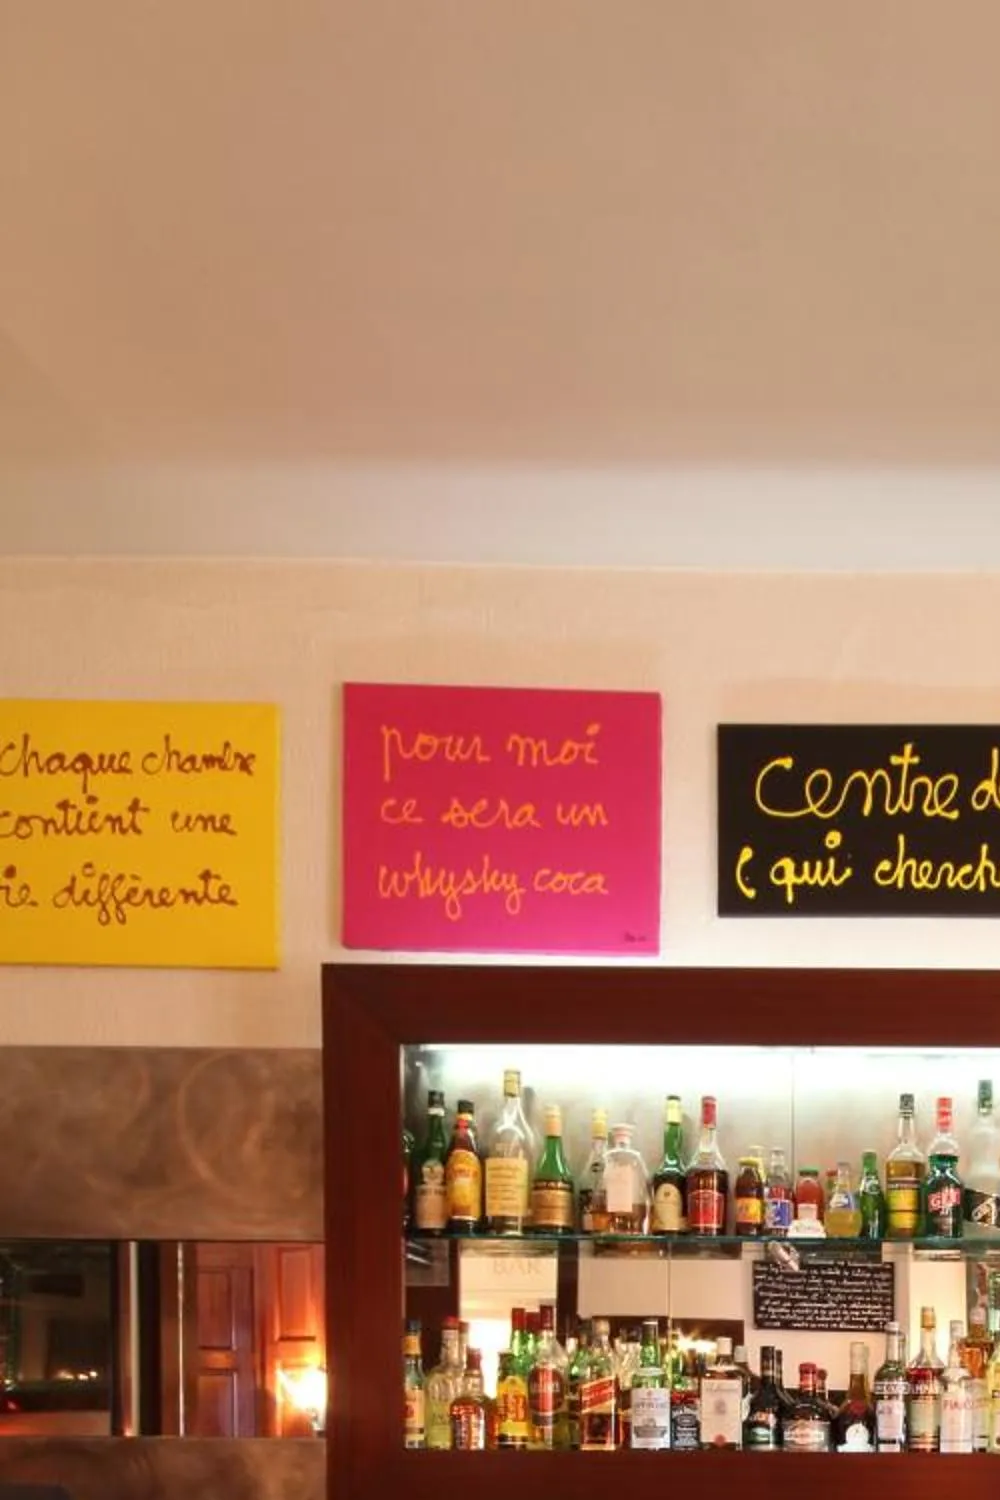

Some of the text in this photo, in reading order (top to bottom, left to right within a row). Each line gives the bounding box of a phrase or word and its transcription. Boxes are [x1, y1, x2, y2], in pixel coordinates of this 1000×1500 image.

[381, 723, 601, 782] pour moi
[170, 810, 238, 837] une
[381, 797, 609, 829] ce sera un
[0, 863, 39, 908] ie
[533, 866, 609, 896] coca
